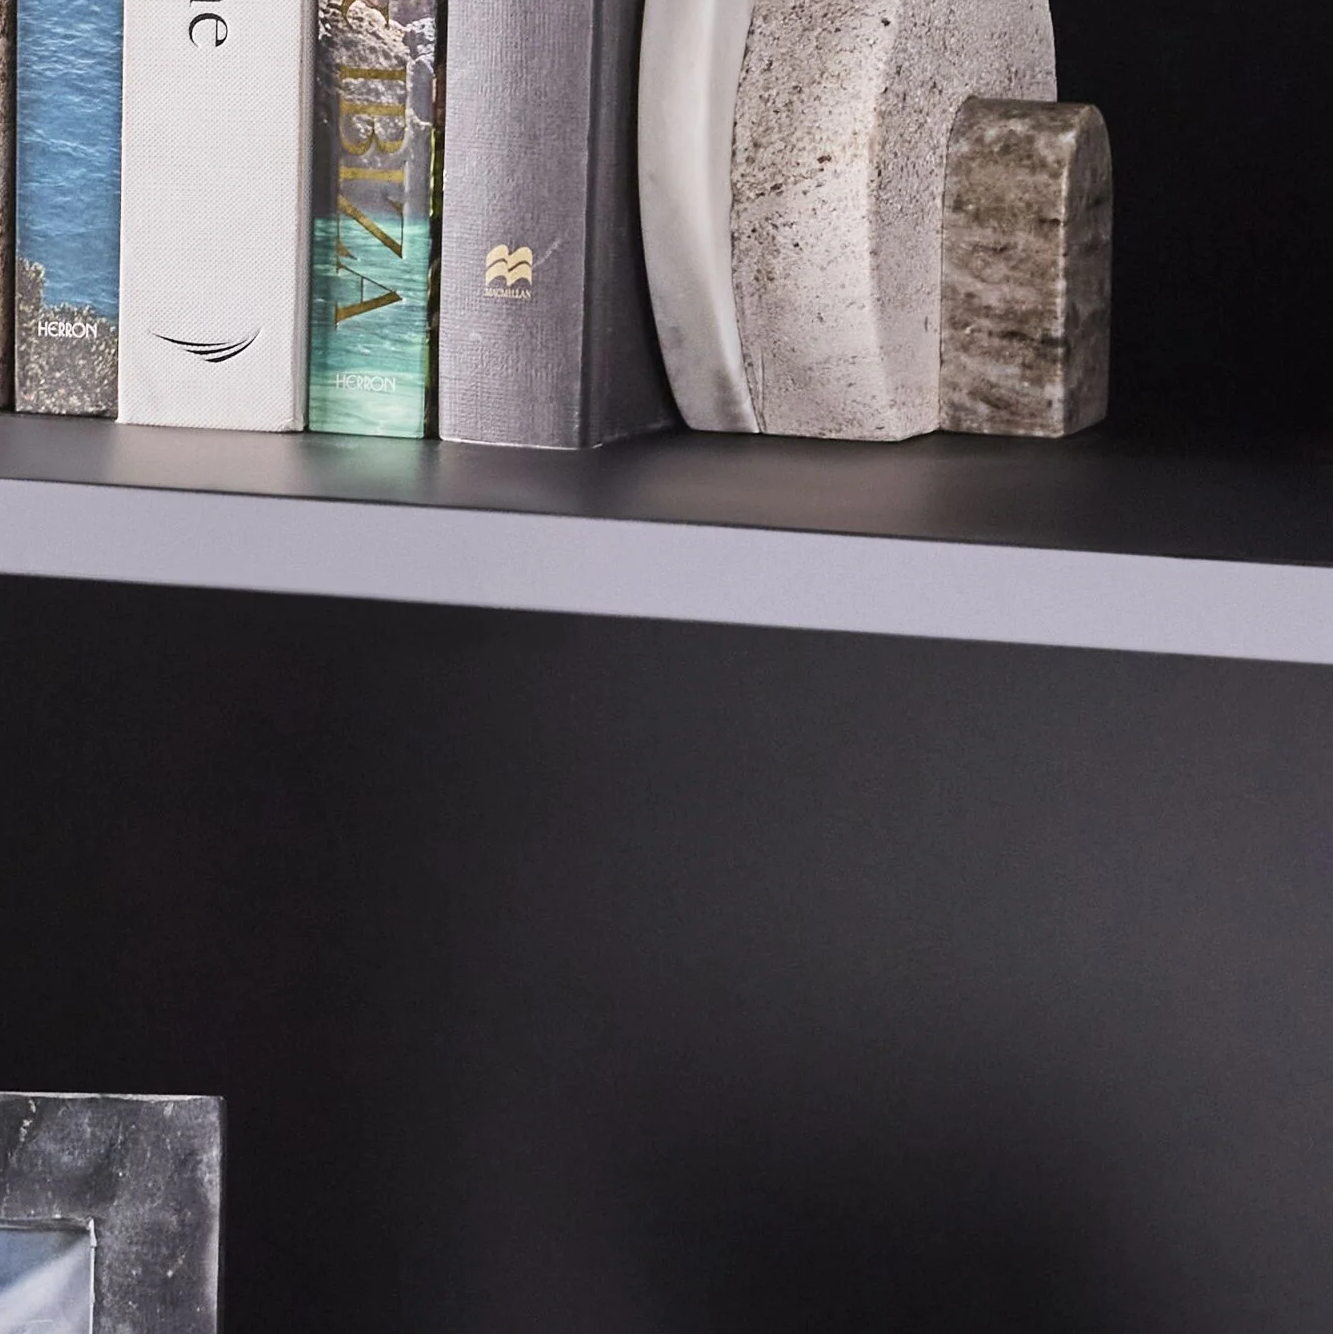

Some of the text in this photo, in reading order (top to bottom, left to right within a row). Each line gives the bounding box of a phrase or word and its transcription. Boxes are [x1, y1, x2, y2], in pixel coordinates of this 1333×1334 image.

[335, 66, 407, 326] IBIZA
[38, 322, 98, 339] HERRON
[335, 373, 397, 393] HERRON
